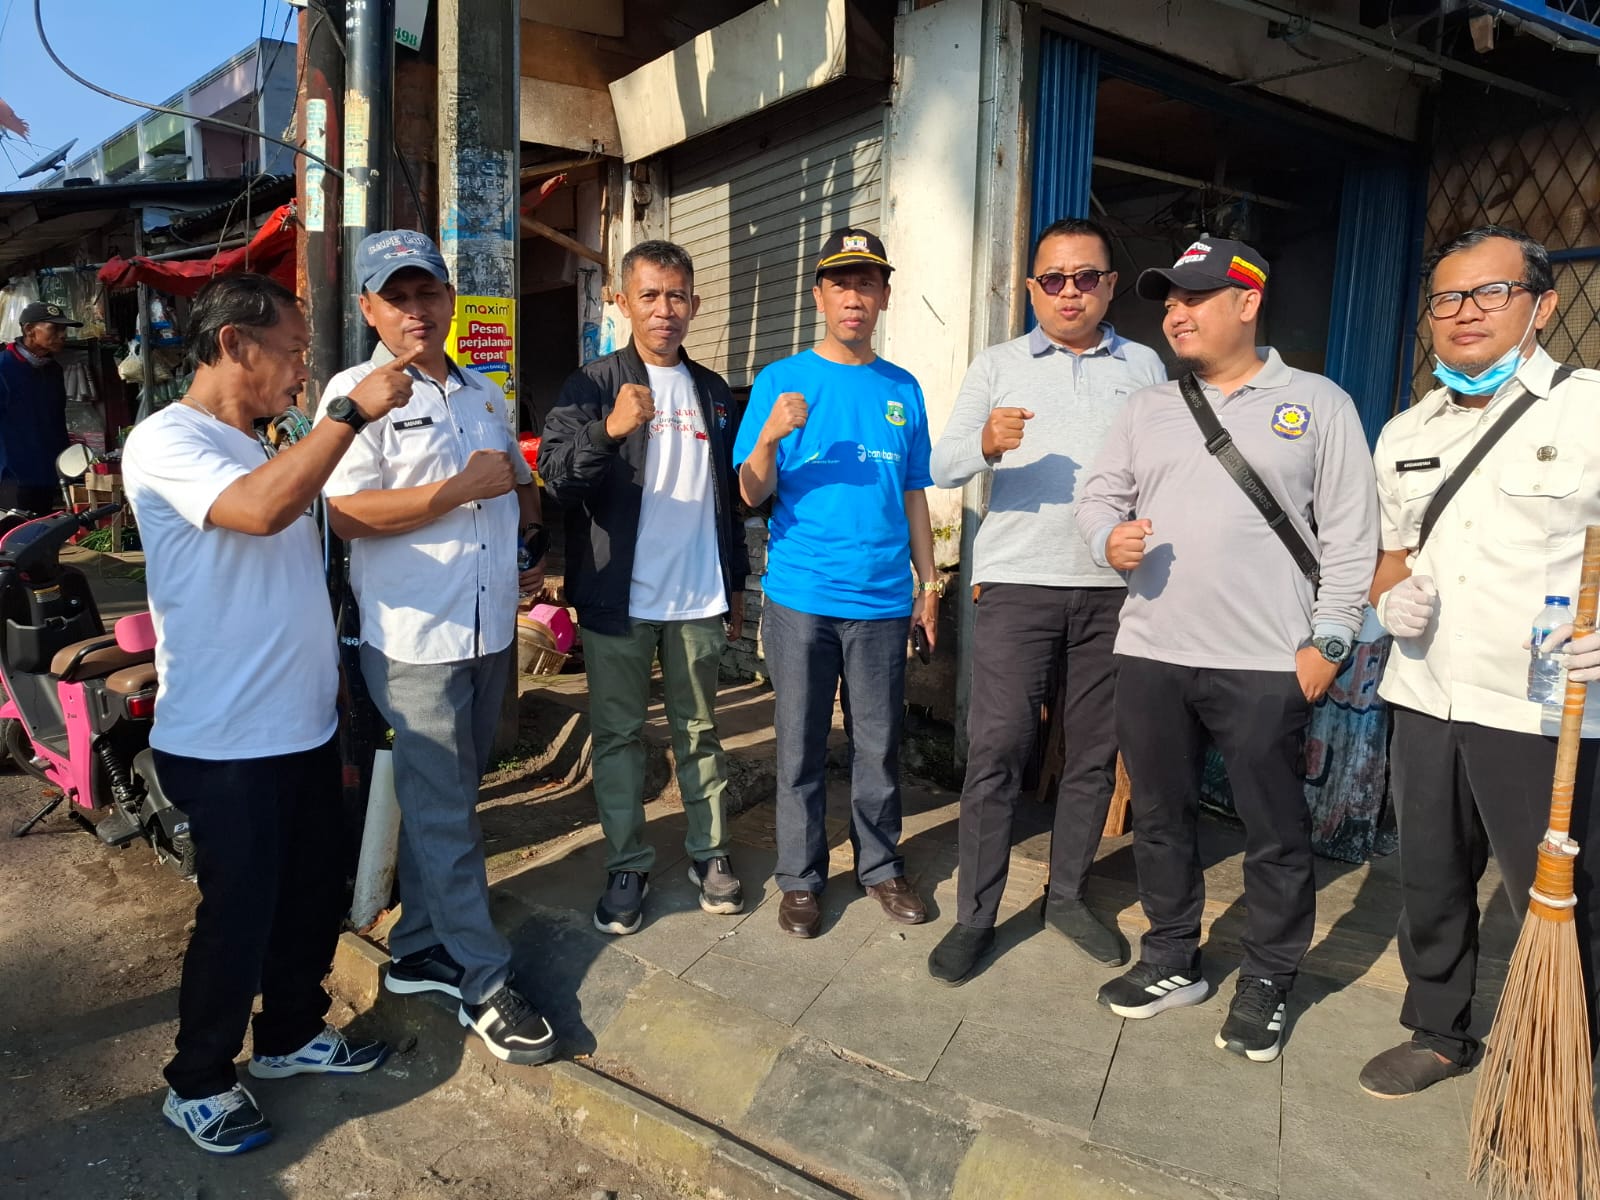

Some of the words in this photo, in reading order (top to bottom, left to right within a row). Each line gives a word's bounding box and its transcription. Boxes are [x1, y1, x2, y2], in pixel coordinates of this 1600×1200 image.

[465, 303, 509, 315] maxim
[471, 323, 504, 334] Pesan
[460, 337, 512, 349] perjalanan
[473, 350, 504, 362] cepat
